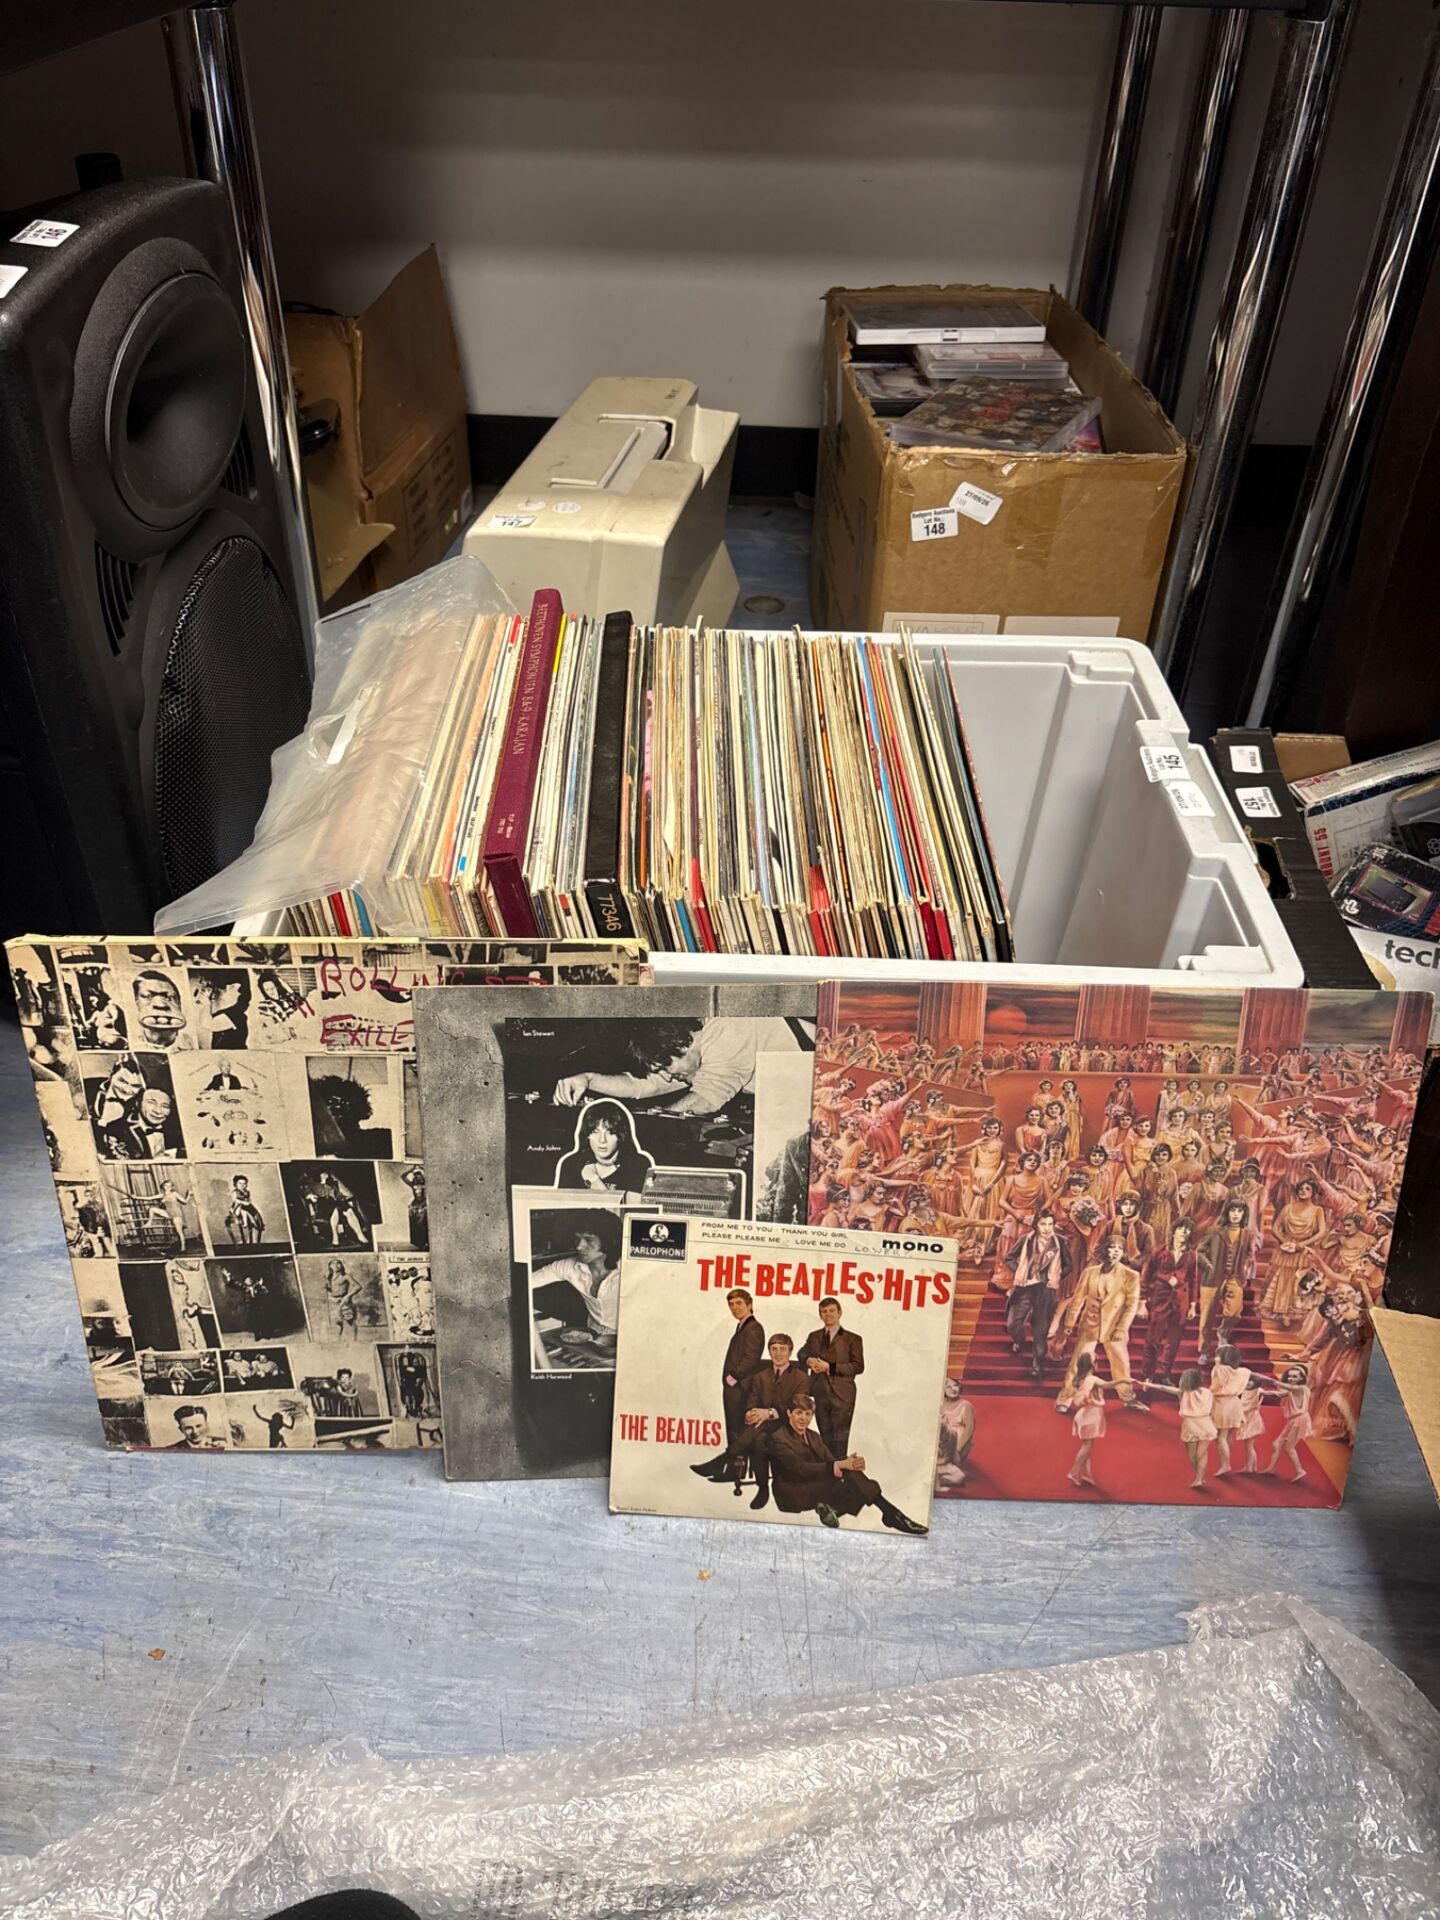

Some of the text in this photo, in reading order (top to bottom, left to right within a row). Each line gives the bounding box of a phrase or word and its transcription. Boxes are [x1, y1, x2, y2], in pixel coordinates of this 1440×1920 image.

[924, 523, 945, 536] 148
[533, 603, 549, 643] BEETHOVEN
[523, 643, 542, 694] SYMPHONIEN
[512, 715, 530, 755] KARAJAN
[1163, 755, 1183, 770] 145
[1243, 797, 1261, 810] 157
[1314, 827, 1334, 880] MOUNT 55
[597, 893, 622, 931] 77346
[527, 1144, 545, 1152] Andy
[702, 1222, 849, 1239] FROM ME TO YOU THANK YOU GIRL
[702, 1232, 733, 1240] PLEASE
[735, 1234, 766, 1242] PLEASE
[795, 1239, 817, 1247] LOVE
[882, 1239, 944, 1254] mono
[630, 1245, 686, 1257] PARLOPHONE
[697, 1254, 752, 1291] THE
[619, 1414, 722, 1447] THE BEATLES
